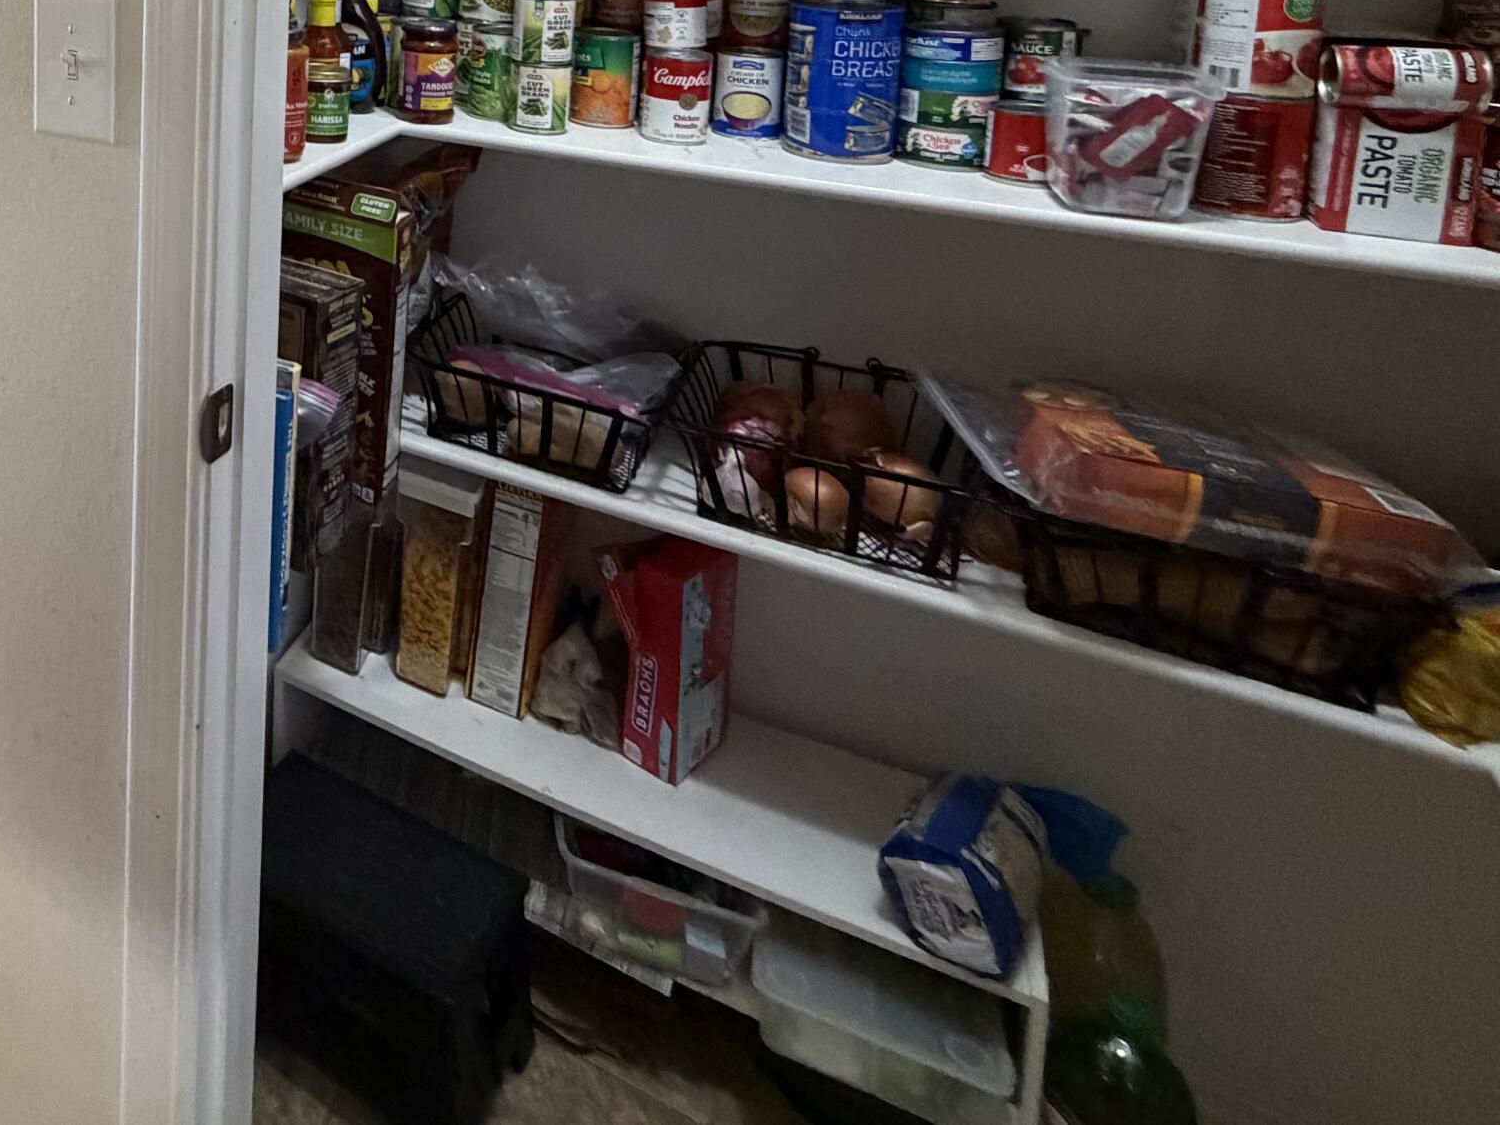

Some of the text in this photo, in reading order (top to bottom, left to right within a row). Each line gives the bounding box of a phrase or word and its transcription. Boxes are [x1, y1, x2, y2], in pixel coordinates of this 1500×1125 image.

[835, 25, 872, 39] Chunk
[1011, 43, 1055, 55] SAUCE
[526, 80, 543, 88] CUT
[727, 75, 770, 86] CHICKEN
[1356, 133, 1398, 210] PASTE
[1393, 153, 1417, 195] TOMATO
[1414, 147, 1446, 204] ORGANIC
[330, 221, 364, 244] SIZE
